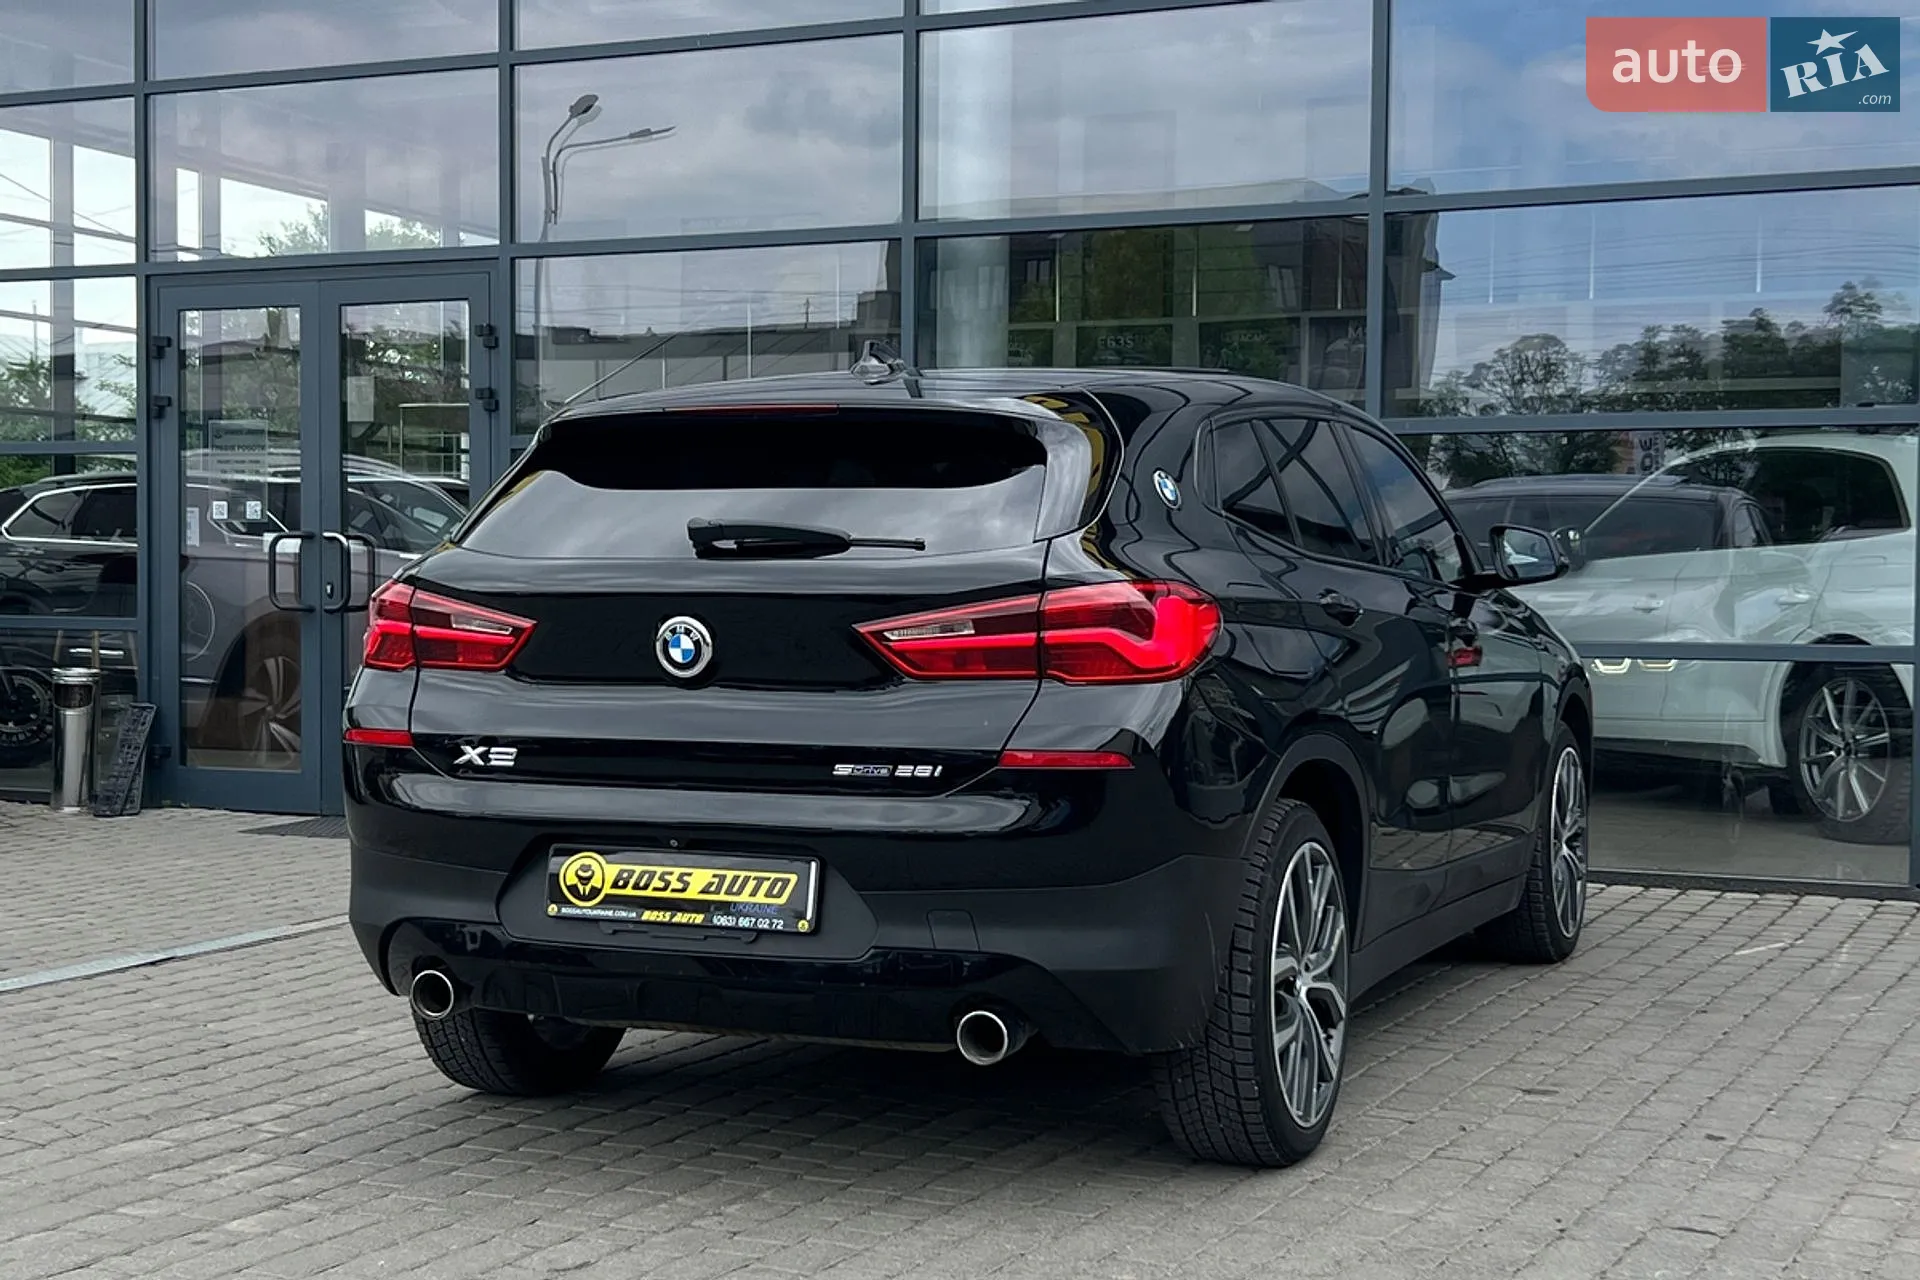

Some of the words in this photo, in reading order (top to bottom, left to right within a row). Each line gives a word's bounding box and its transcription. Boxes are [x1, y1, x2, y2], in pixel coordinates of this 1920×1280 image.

[453, 745, 518, 767] X2
[610, 868, 694, 893] BOSS
[698, 873, 792, 899] AUTO
[729, 903, 779, 914] UKRAINE
[641, 910, 672, 922] BOSS
[671, 911, 706, 925] AUTO
[756, 919, 771, 930] 02
[770, 919, 785, 930] 72
